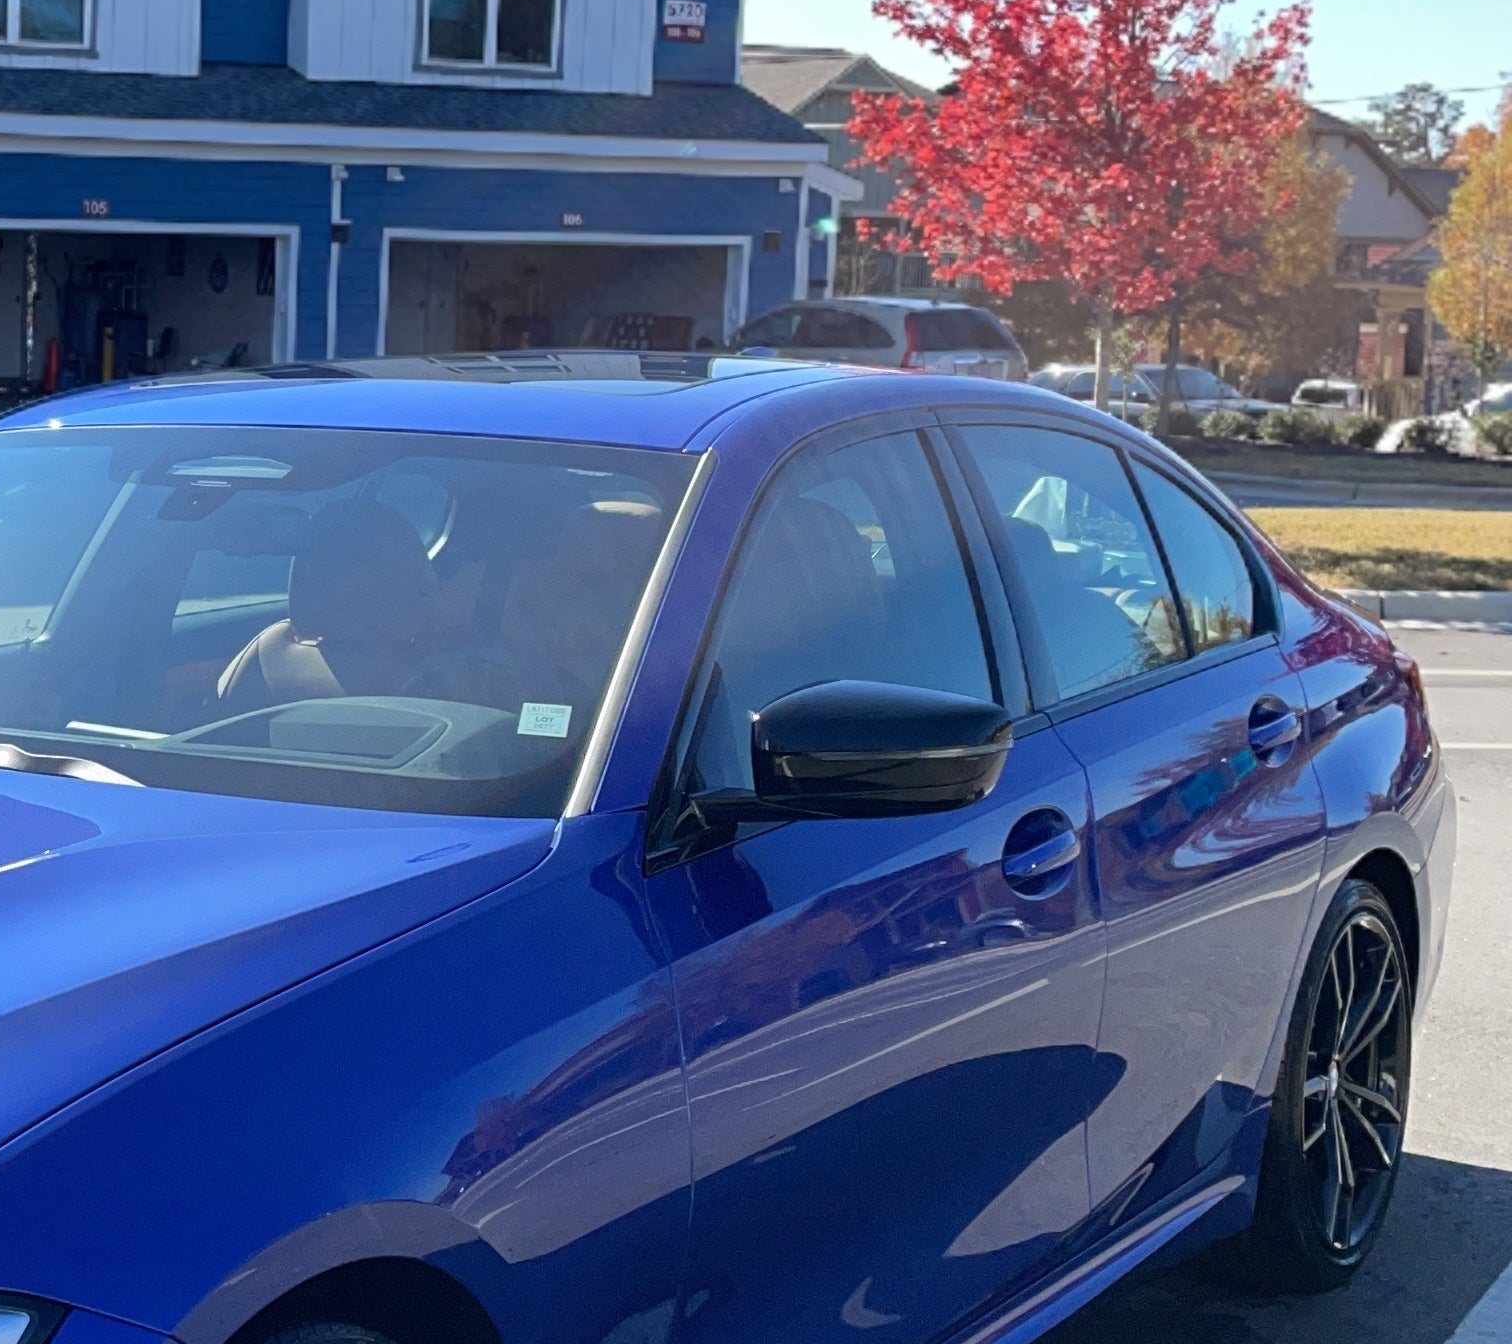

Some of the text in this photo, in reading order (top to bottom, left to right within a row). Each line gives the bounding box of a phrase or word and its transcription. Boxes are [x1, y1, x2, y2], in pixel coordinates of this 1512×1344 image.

[667, 3, 703, 18] 5720
[83, 201, 108, 215] 105
[563, 213, 583, 226] 106
